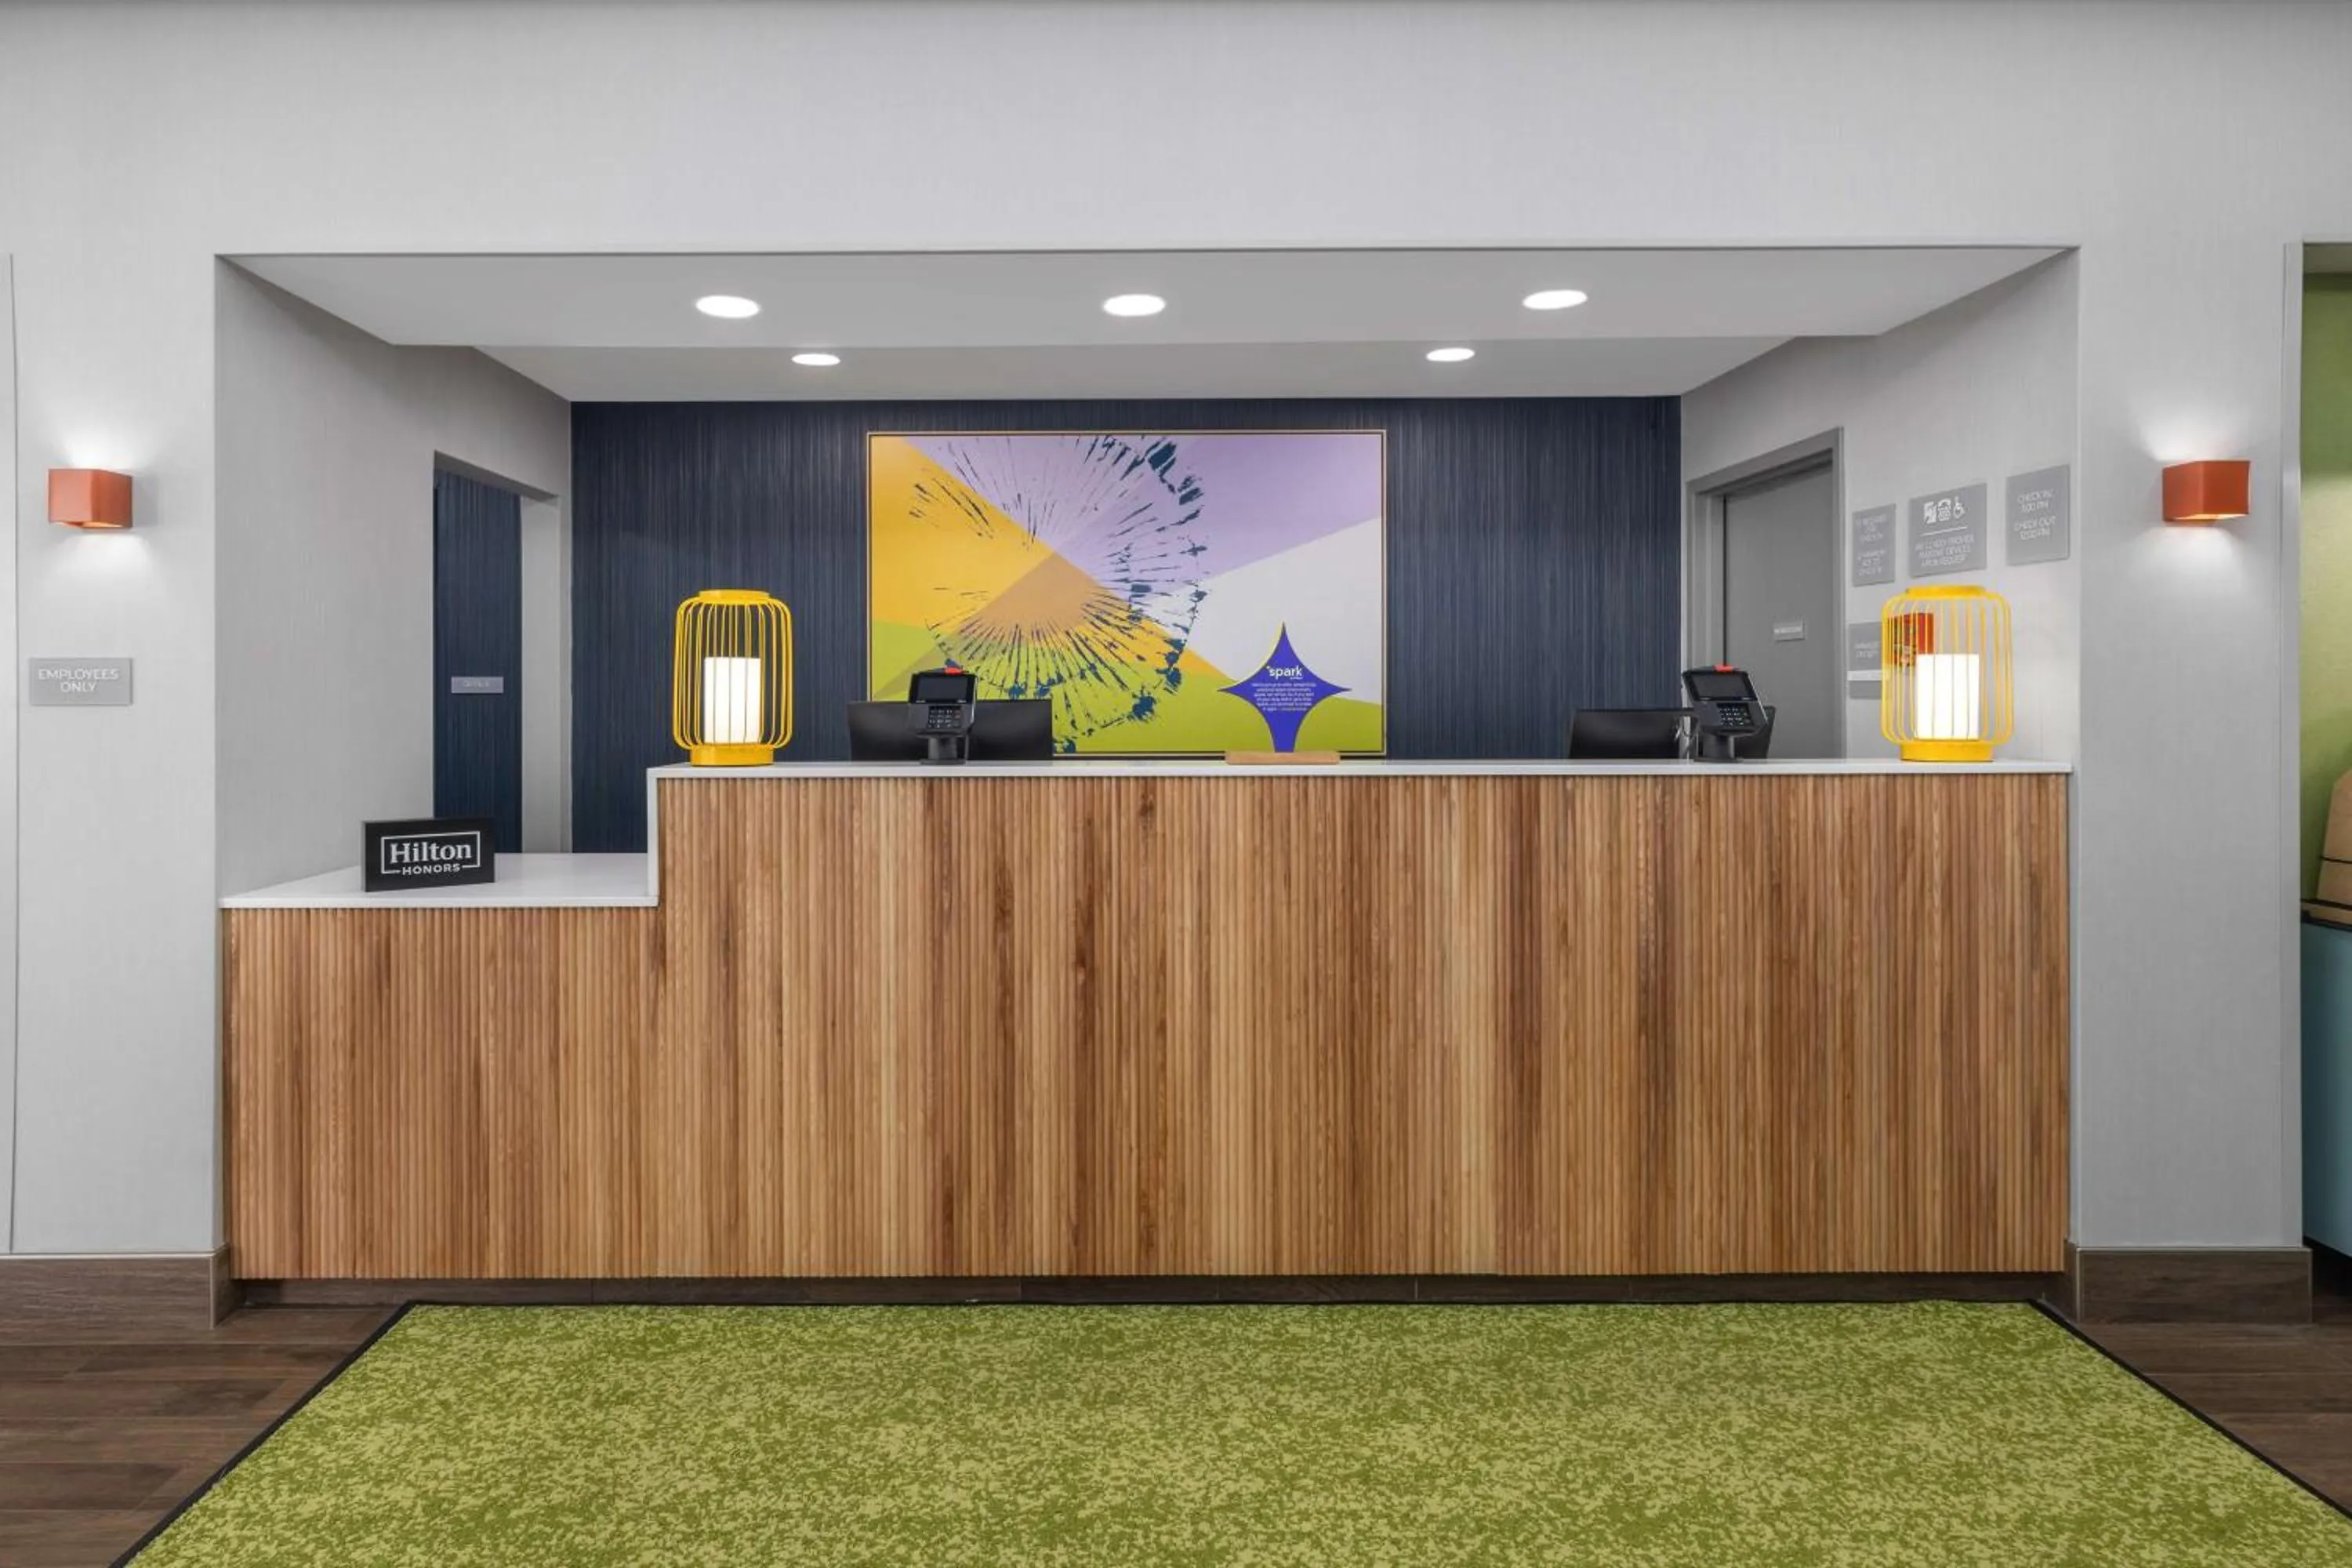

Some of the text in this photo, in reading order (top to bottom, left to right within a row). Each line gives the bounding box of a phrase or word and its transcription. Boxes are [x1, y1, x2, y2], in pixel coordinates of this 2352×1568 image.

[38, 668, 120, 681] EMPLOYEES
[1269, 665, 1303, 681] spark
[60, 681, 98, 693] ONLY
[390, 841, 473, 864] Hilton
[402, 863, 461, 876] HONORS
